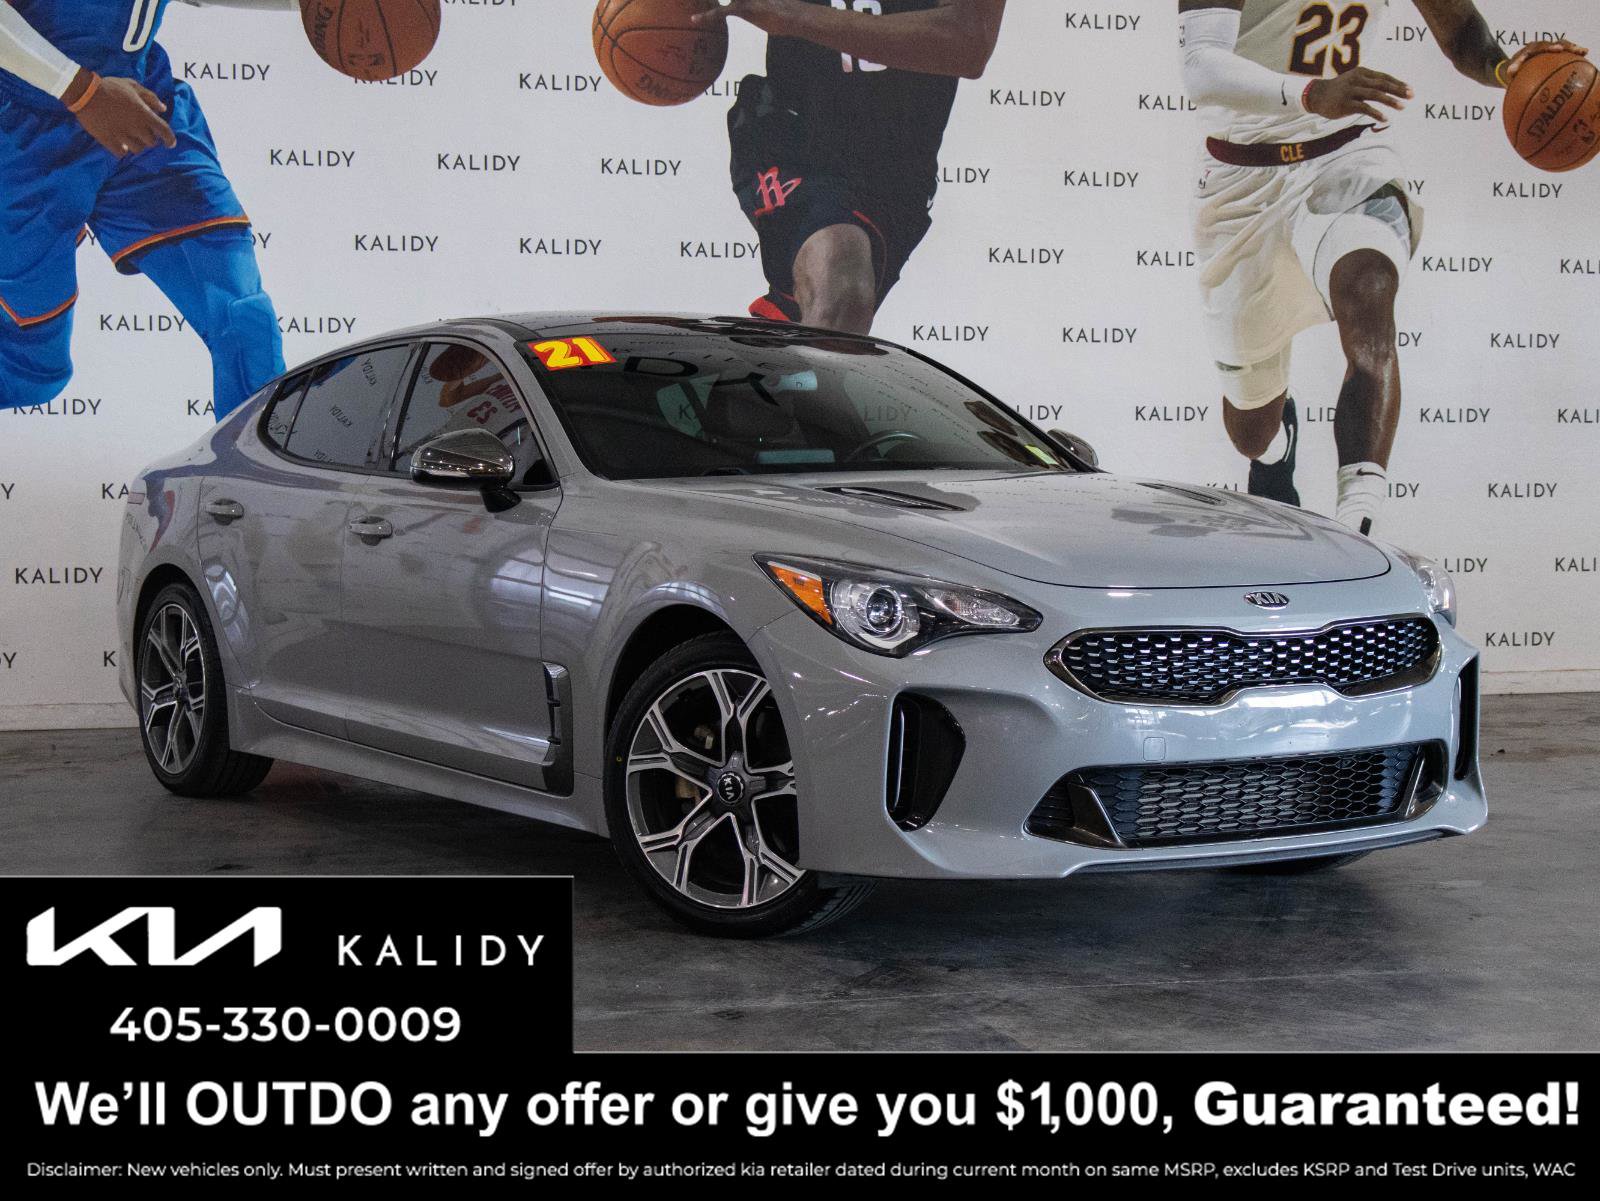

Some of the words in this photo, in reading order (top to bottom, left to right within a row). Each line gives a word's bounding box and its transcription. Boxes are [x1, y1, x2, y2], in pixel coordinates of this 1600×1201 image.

[1065, 12, 1141, 31] KALIDY
[1290, 2, 1368, 76] 23
[184, 62, 270, 81] KALIDY
[519, 72, 602, 92] KALIDY
[990, 89, 1066, 107] KALIDY
[1425, 104, 1496, 121] KALIDY
[270, 149, 356, 168] KALIDY
[1280, 143, 1305, 163] CLE
[437, 153, 521, 172] KALIDY
[601, 158, 682, 176] KALIDY
[936, 167, 991, 185] LIDY
[1064, 170, 1139, 188] KALIDY
[1493, 182, 1563, 199] KALIDY
[355, 234, 439, 253] KALIDY
[519, 237, 602, 256] KALIDY
[680, 240, 759, 259] KALIDY
[989, 247, 1065, 265] KALIDY
[1422, 256, 1493, 273] KALIDY
[100, 314, 186, 332] KALIDY
[912, 325, 989, 342] KALIDY
[1062, 327, 1137, 344] KALIDY
[1490, 333, 1560, 349] KALIDY
[534, 338, 611, 368] 21
[1135, 405, 1209, 422] KALIDY
[1419, 407, 1491, 423] KALIDY
[1487, 482, 1558, 498] KALIDY
[1444, 557, 1488, 573] LIDY
[15, 566, 104, 585] KALIDY
[1250, 592, 1288, 605] KIA
[1485, 631, 1556, 647] KALIDY
